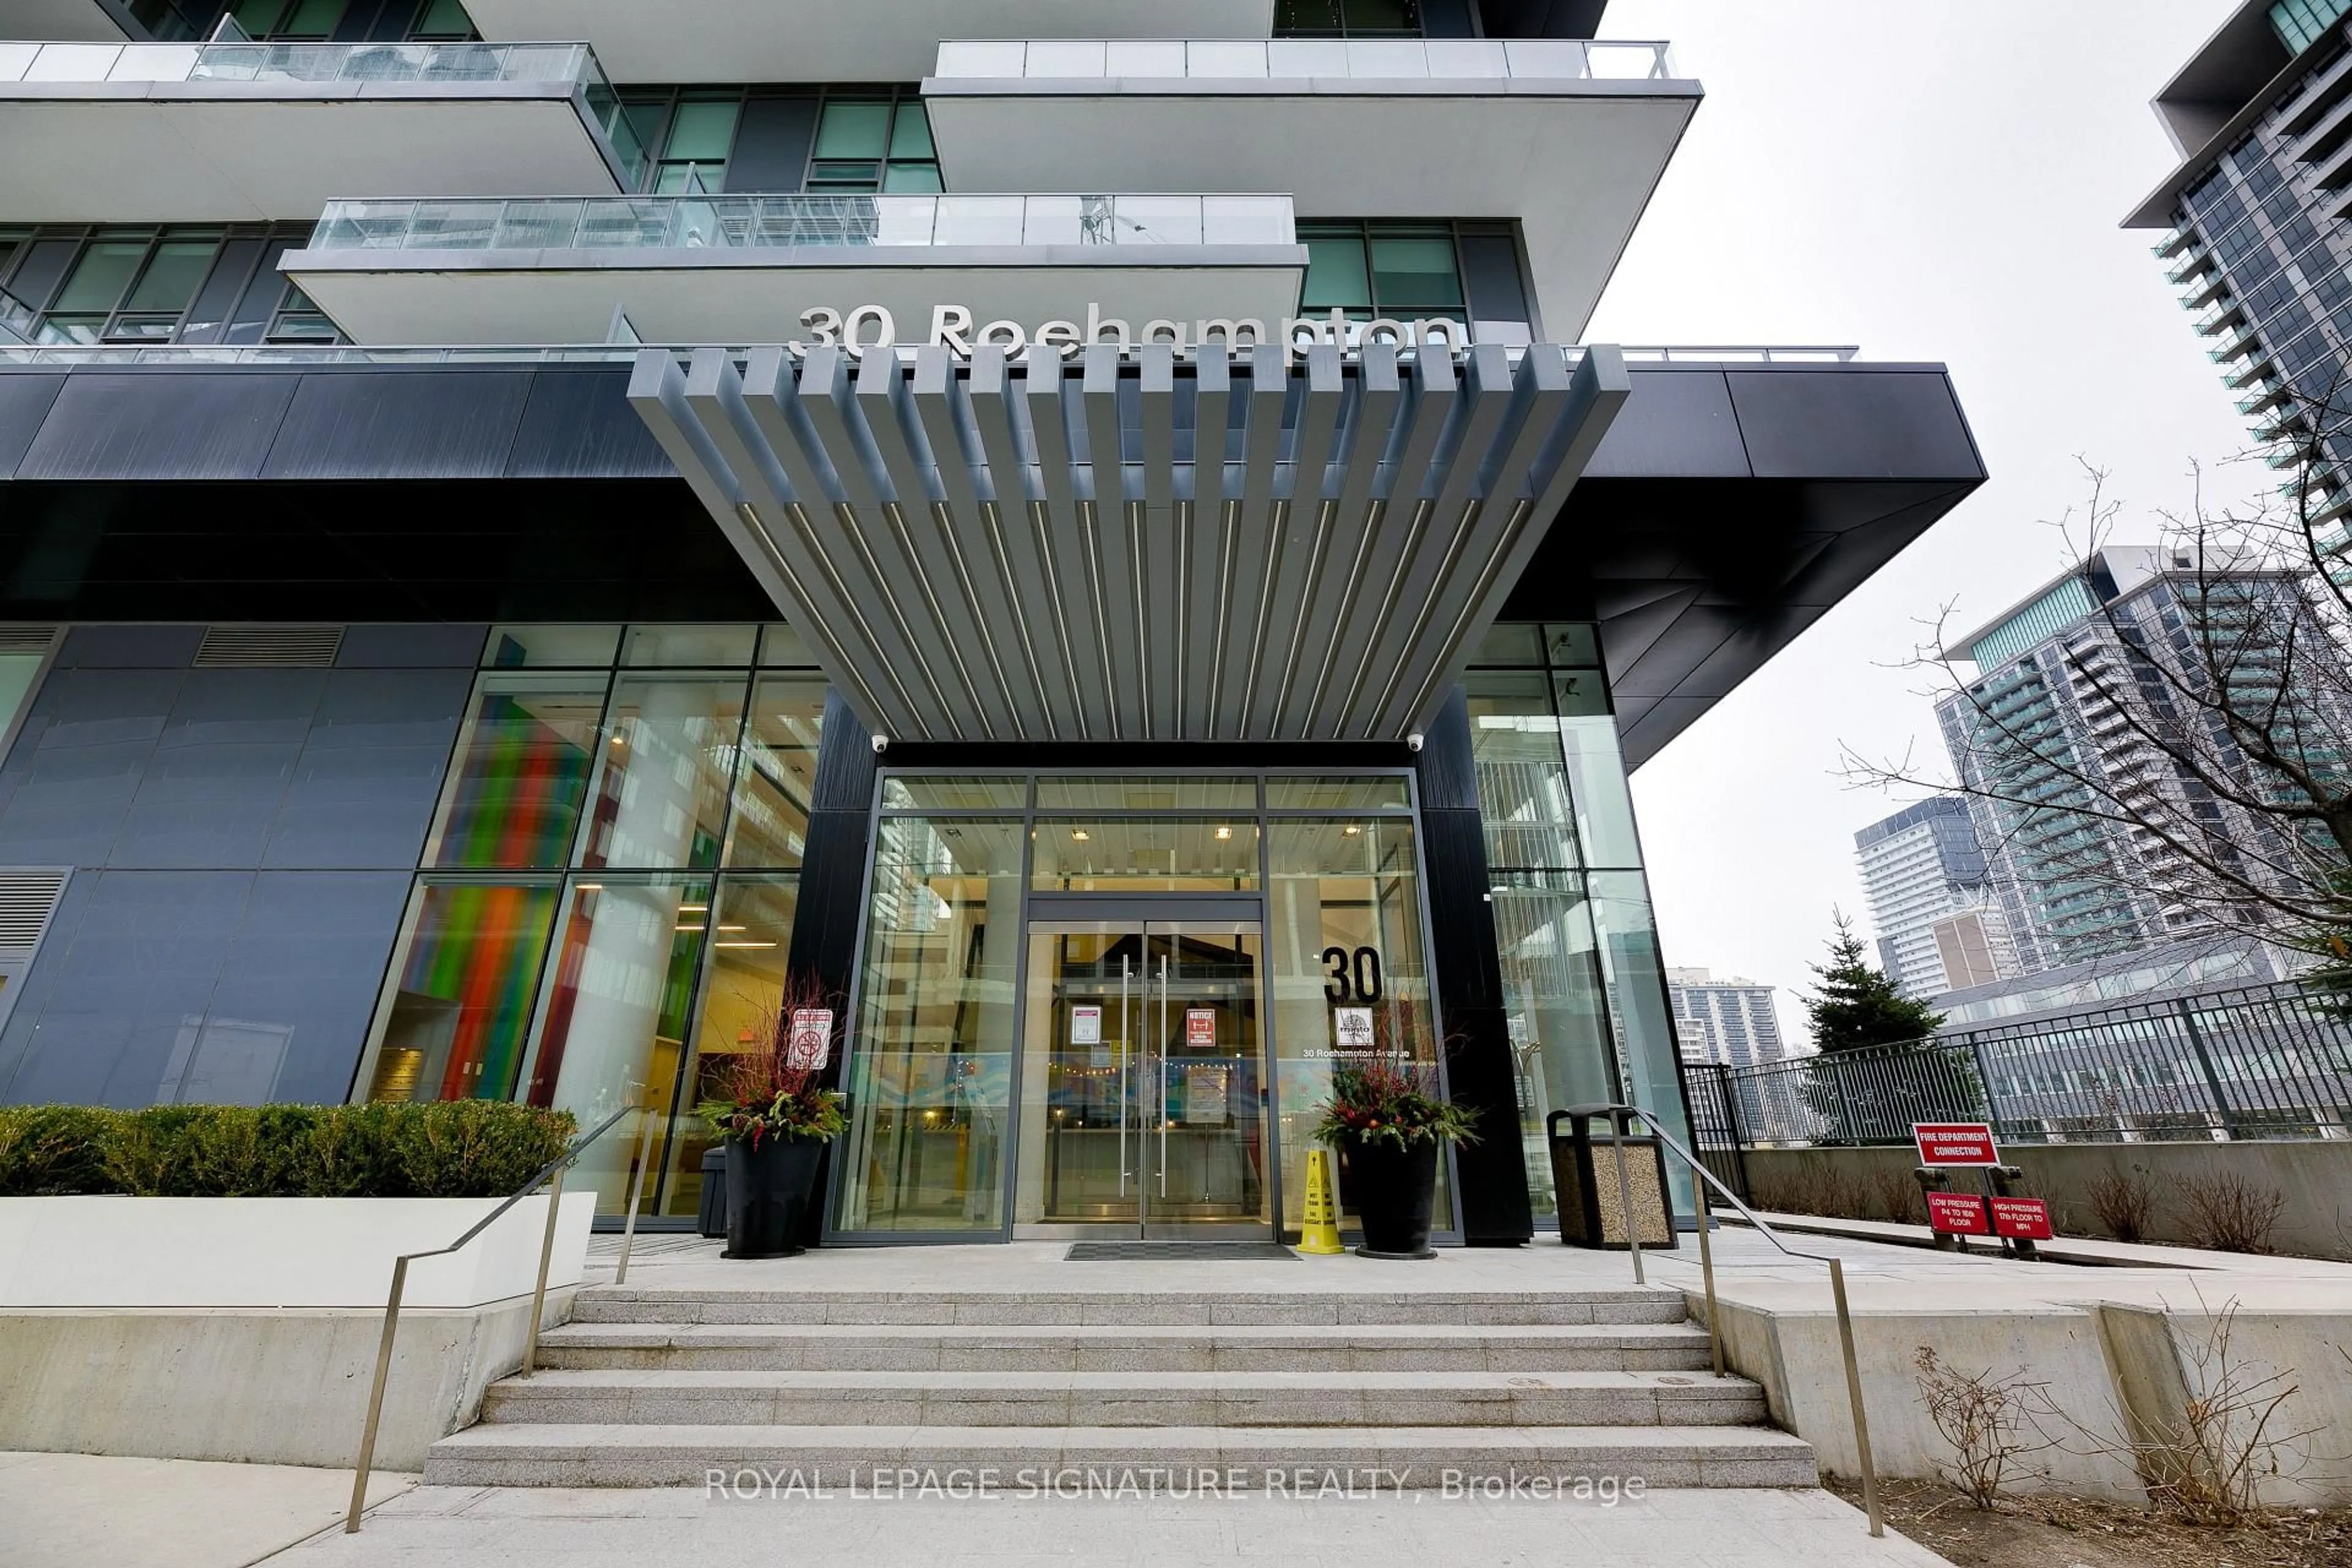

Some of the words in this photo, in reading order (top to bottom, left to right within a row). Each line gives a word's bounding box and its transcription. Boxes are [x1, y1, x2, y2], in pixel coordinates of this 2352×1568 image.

[789, 304, 895, 363] 30
[930, 303, 1462, 372] Roehampton
[1322, 946, 1382, 1004] 30
[1303, 1049, 1314, 1058] 30
[1317, 1049, 1374, 1059] Roehampton
[1376, 1049, 1410, 1058] Avenue
[1920, 1133, 1938, 1141] FIRE
[1938, 1133, 1988, 1141] DEPARTMENT
[1934, 1147, 1983, 1156] CONNECTION
[1932, 1198, 1947, 1207] LOW
[1947, 1199, 1980, 1208] PRESSURE
[2010, 1204, 2043, 1213] PRESSURE
[1948, 1218, 1971, 1226] FLOOR
